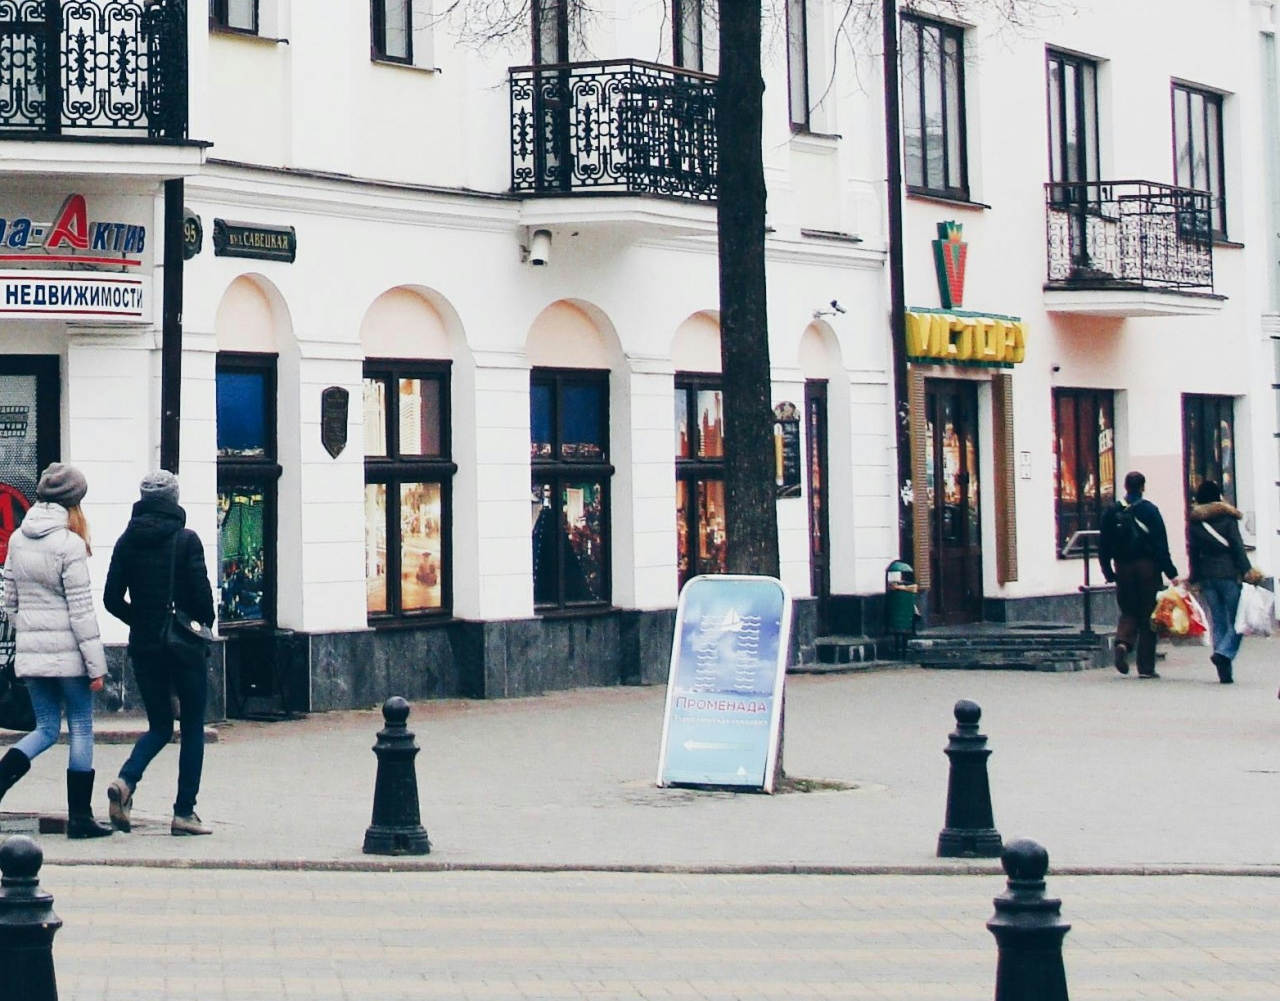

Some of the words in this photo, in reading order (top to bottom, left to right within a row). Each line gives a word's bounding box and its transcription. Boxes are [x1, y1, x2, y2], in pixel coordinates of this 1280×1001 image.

[184, 223, 197, 243] 95
[244, 231, 288, 249] САВЕЦКАЯ
[6, 285, 143, 309] НЕДВИЖИМОСТИ
[676, 696, 767, 714] ПРОМЕНАДА
